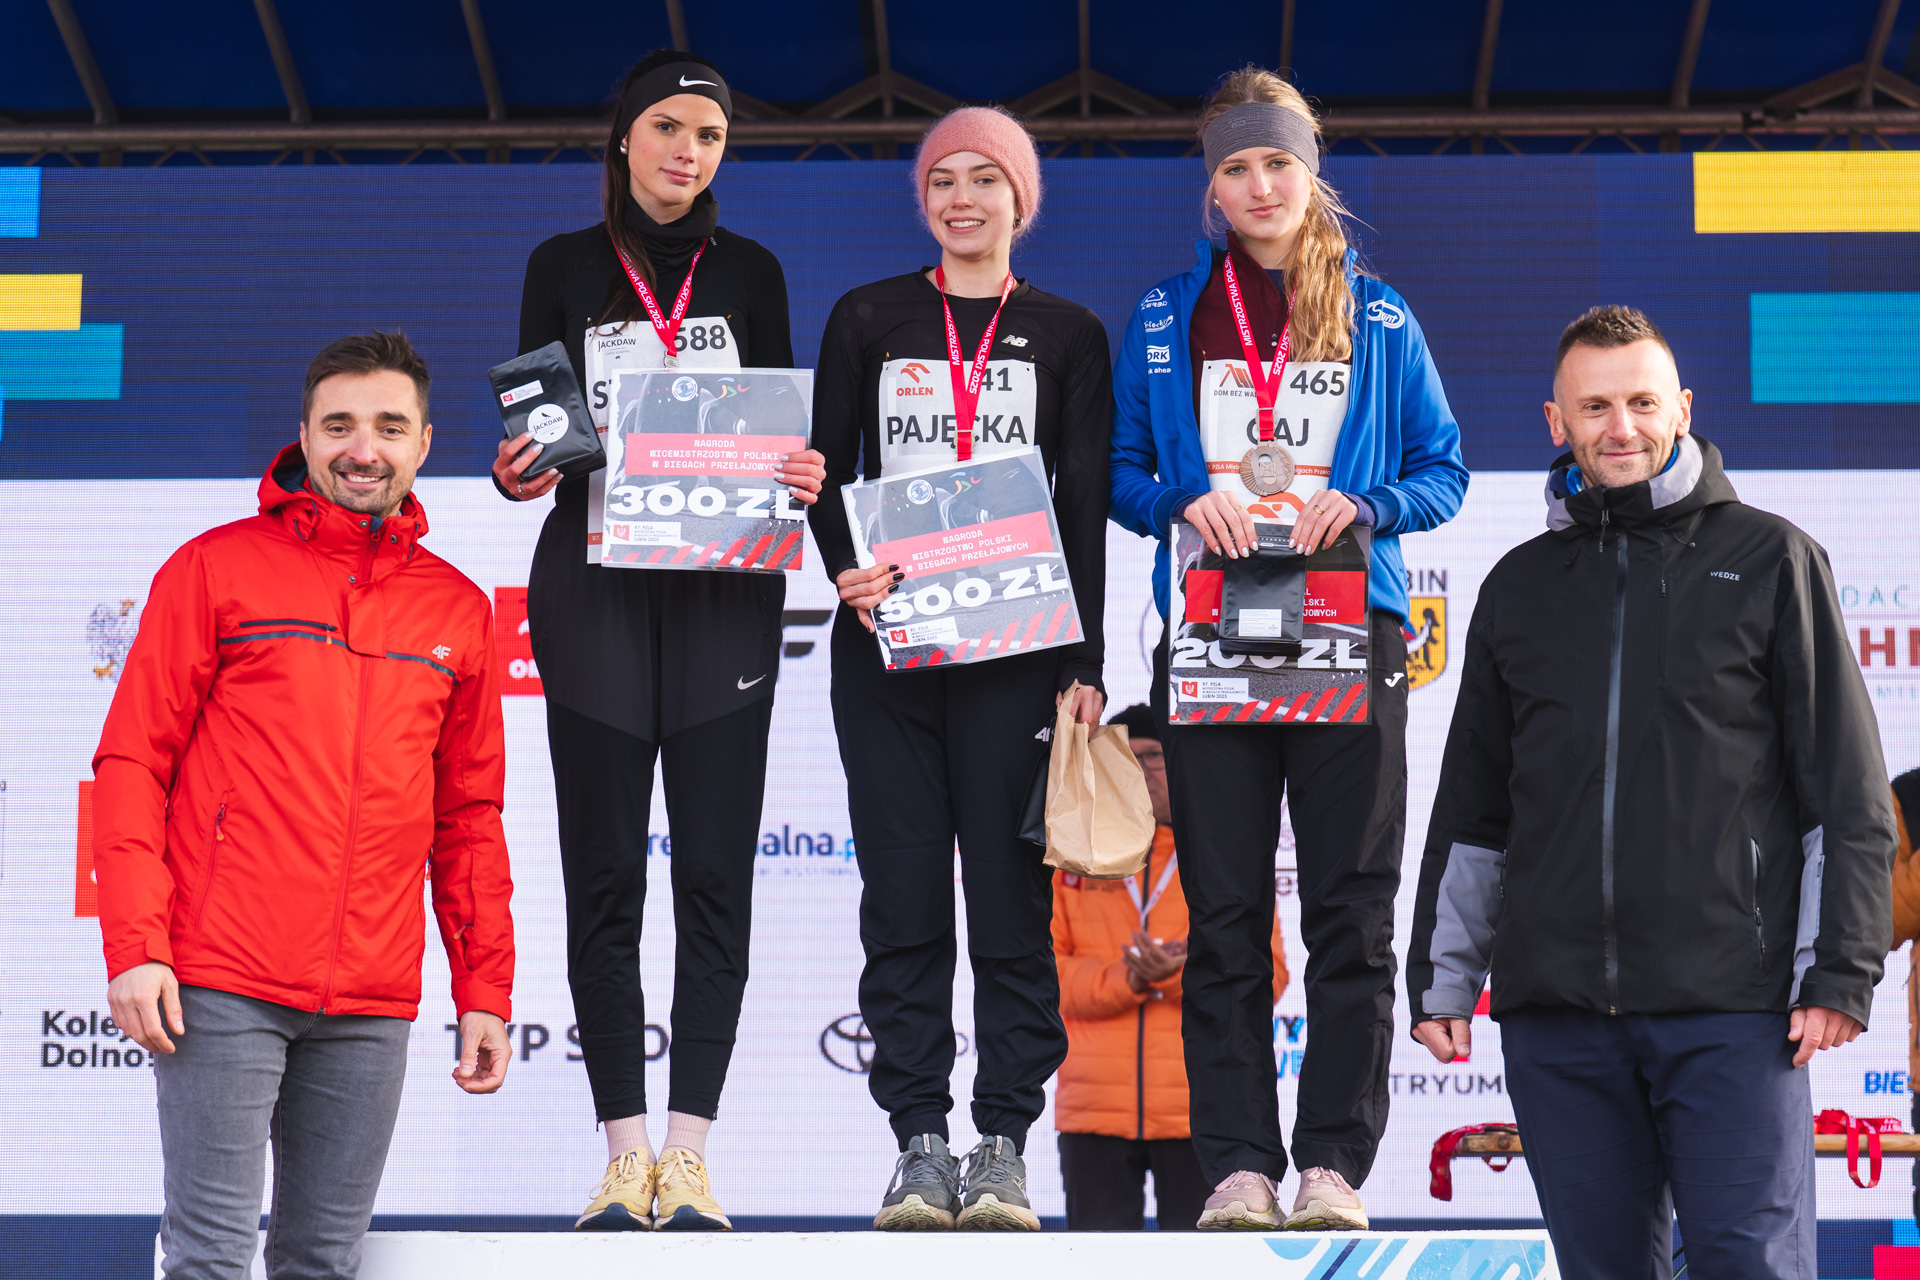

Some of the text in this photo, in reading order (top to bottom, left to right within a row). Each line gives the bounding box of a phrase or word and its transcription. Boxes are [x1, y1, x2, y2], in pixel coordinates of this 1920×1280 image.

[636, 281, 655, 308] POLSKI
[650, 308, 665, 330] 2025
[672, 299, 686, 320] 2025
[1230, 283, 1253, 346] MISTRZOSTWA
[598, 338, 636, 352] JACKDAW
[674, 325, 727, 352] 588
[975, 338, 990, 370] POLSKI
[1147, 351, 1168, 360] ORK
[1273, 350, 1286, 376] 2025
[896, 387, 934, 396] ORLEN
[969, 370, 982, 394] 2025
[1290, 370, 1345, 396] 465
[592, 379, 611, 410] S
[533, 416, 563, 434] JACKDAW
[650, 450, 779, 460] WICEMISTRZOSTWO POLSKI
[694, 440, 736, 448] NAGRODA
[664, 460, 706, 469] BIEGACH
[711, 462, 776, 471] PRZEŁAJOWYC
[1226, 462, 1240, 470] Mistr
[608, 485, 806, 520] 300 ZŁ
[912, 534, 1012, 561] MISTRZOSTWO POLSKI
[942, 530, 984, 544] NAGRODA
[906, 542, 1028, 572] W BIEGACH PRZEŁAJOWYCH
[1710, 571, 1740, 581] WEDZE
[880, 563, 1069, 622] 500 ZŁ
[1302, 598, 1326, 606] LSKI
[1302, 608, 1337, 617] JOWYCH
[432, 644, 452, 660] 4F
[1298, 638, 1366, 668] ZŁ
[42, 1010, 130, 1042] Kole
[1864, 1072, 1911, 1094] BIE
